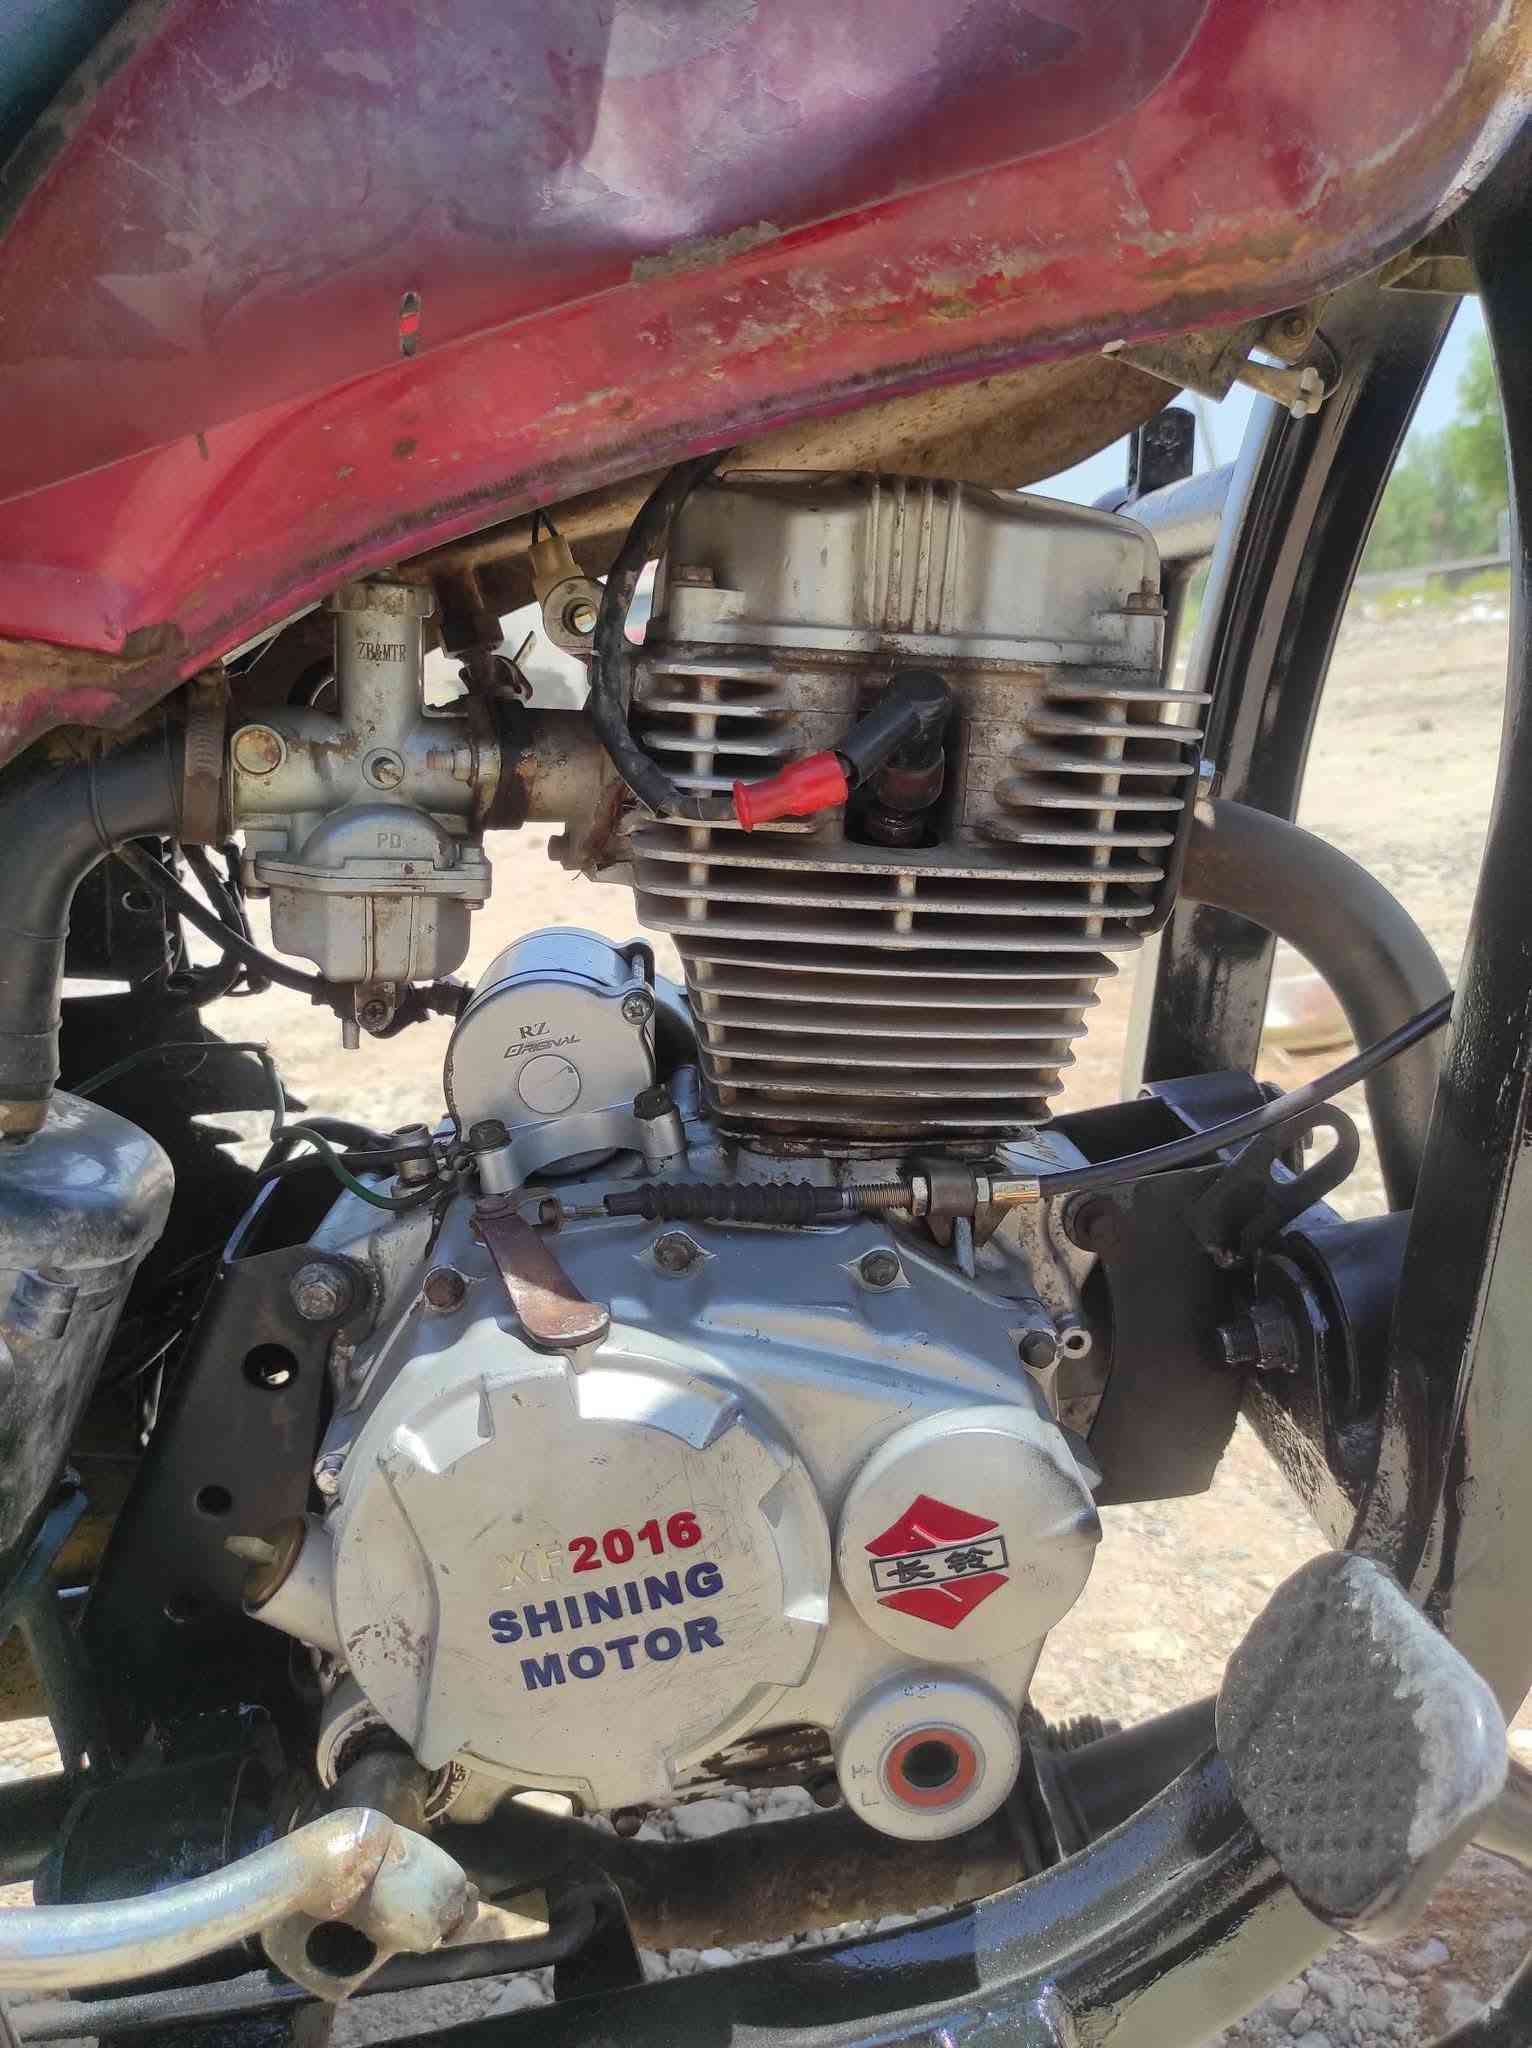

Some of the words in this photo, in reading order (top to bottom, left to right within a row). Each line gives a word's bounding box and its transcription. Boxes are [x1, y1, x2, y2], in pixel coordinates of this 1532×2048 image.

[519, 1022, 550, 1039] RZ
[488, 1561, 724, 1643] SHINING
[520, 1615, 724, 1691] MOTOR
